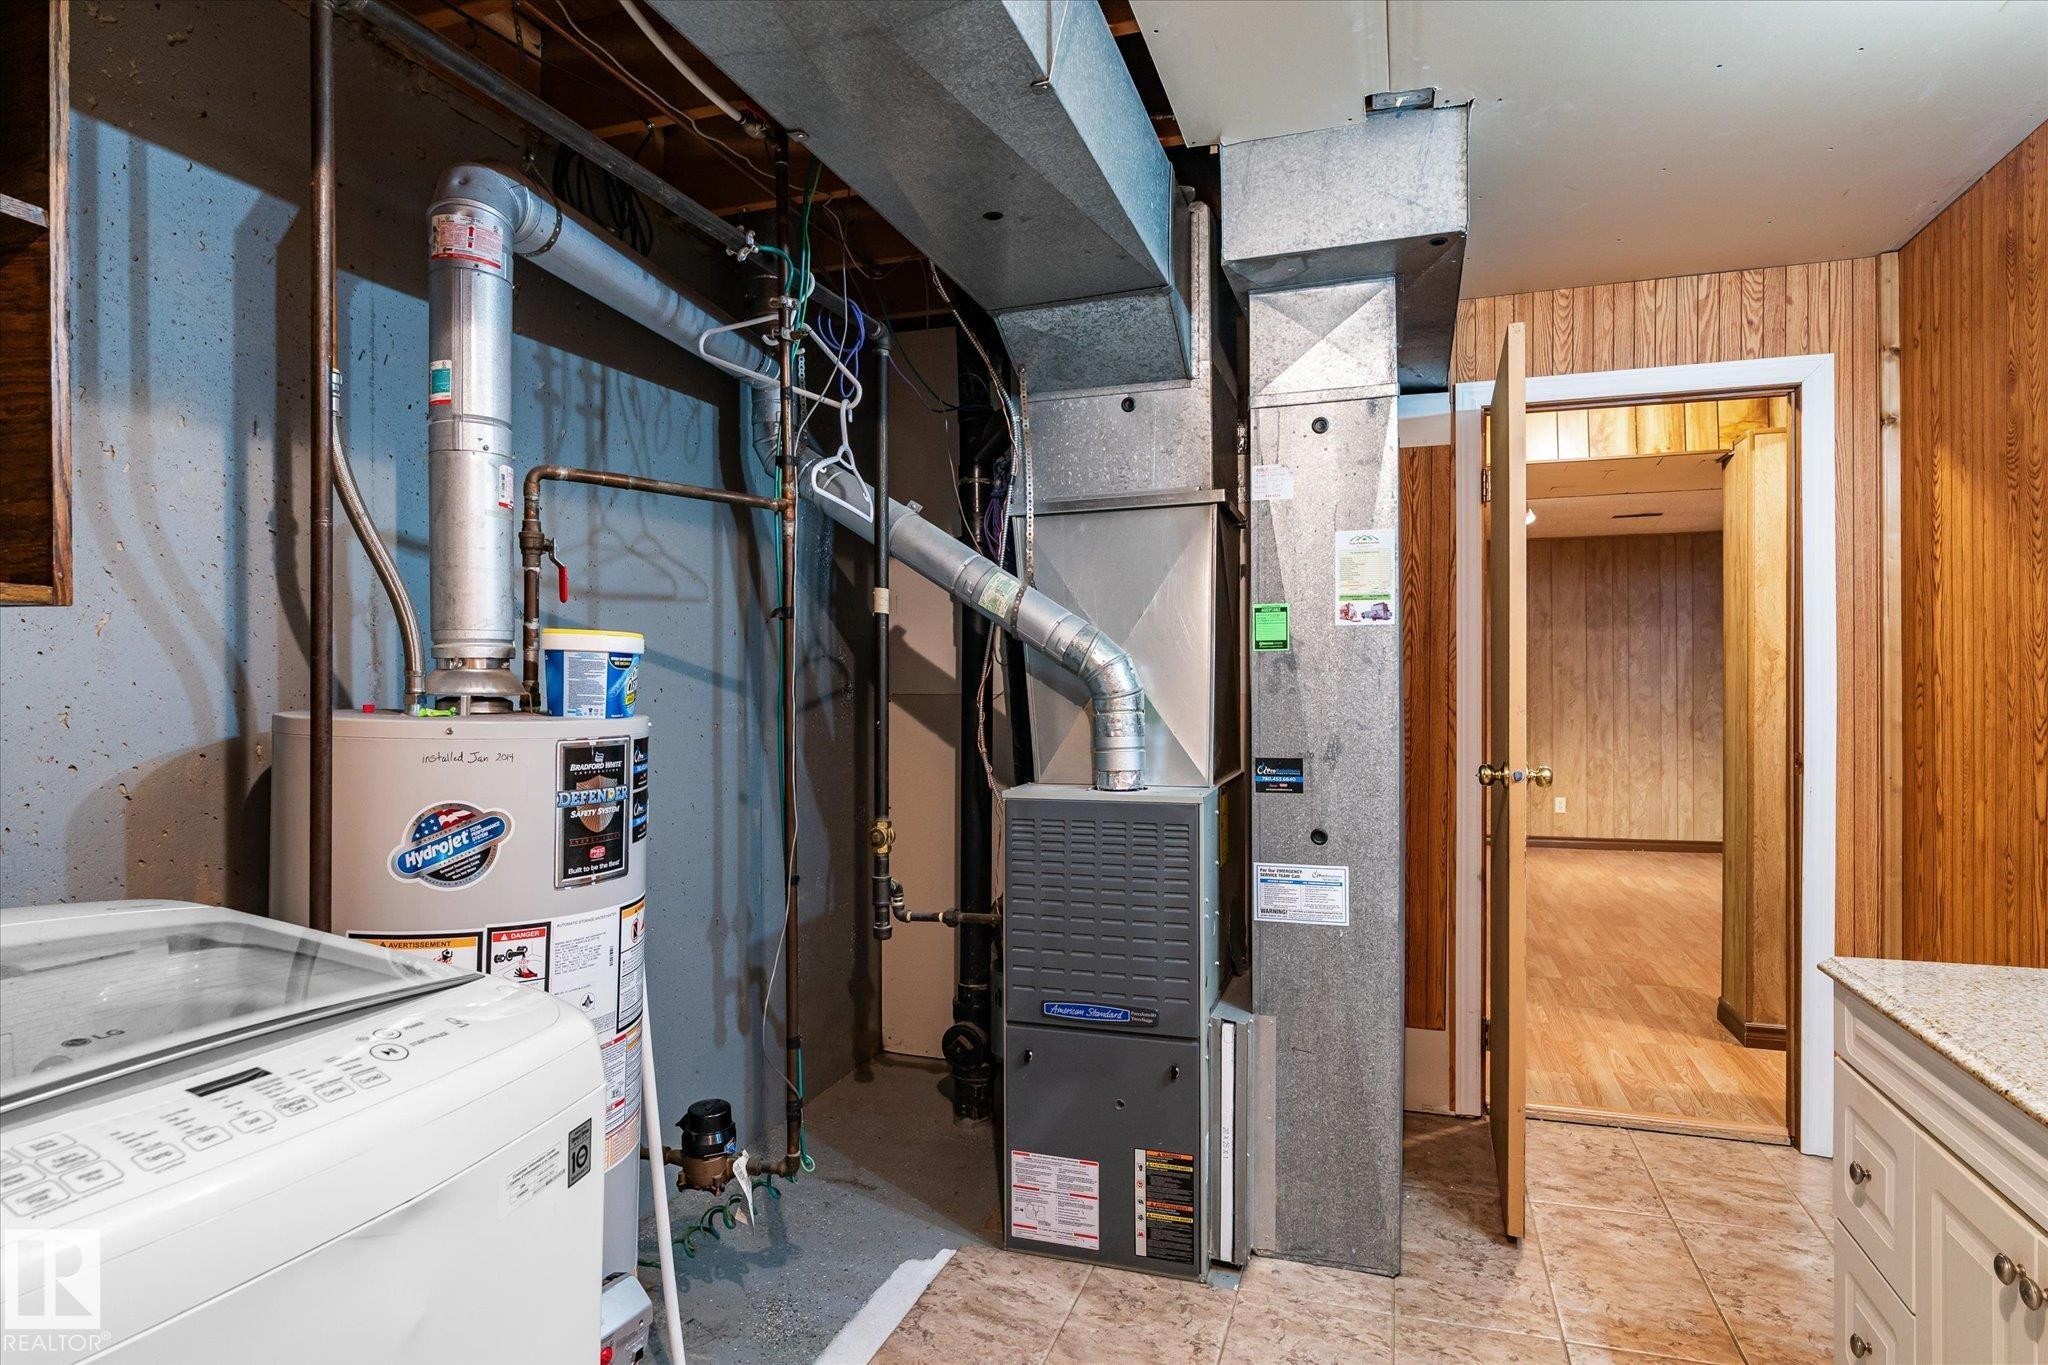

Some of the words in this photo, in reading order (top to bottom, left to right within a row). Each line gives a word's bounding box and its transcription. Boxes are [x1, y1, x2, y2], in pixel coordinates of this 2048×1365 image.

[422, 751, 464, 763] installed
[467, 752, 489, 763] Jan
[496, 753, 514, 762] 2014
[570, 762, 605, 772] BRADFORD
[605, 760, 623, 768] WHITE
[558, 786, 629, 807] DEFENDER
[570, 808, 597, 819] SAFETY
[597, 805, 620, 815] SYSTEM
[405, 831, 469, 868] Hydrojet
[568, 866, 583, 875] Built
[590, 862, 599, 871] be
[510, 930, 540, 939] DANGER
[388, 941, 451, 949] AVERTISSEMENT
[1050, 1004, 1085, 1016] American
[1086, 1007, 1123, 1019] Standard
[92, 1029, 125, 1039] LG
